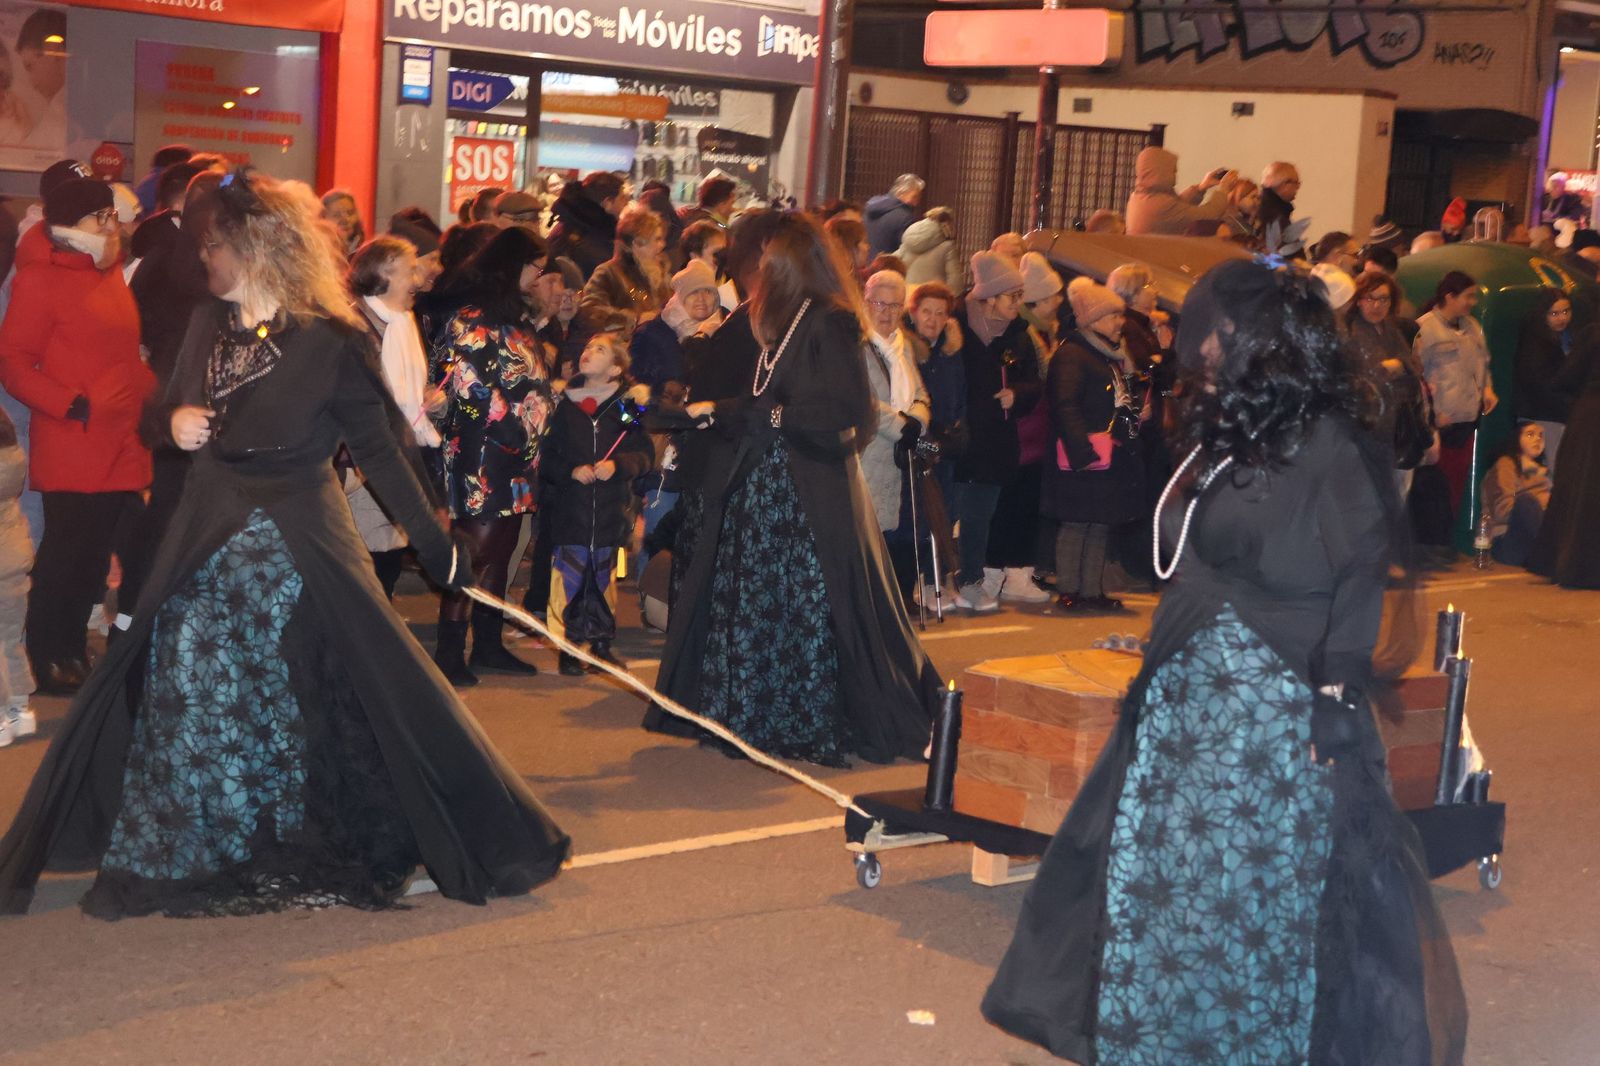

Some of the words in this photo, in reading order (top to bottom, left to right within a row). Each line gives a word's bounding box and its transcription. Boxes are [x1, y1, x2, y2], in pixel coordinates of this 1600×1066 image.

[618, 6, 743, 57] Móviles
[452, 80, 493, 103] DIGI
[455, 144, 510, 182] SOS
